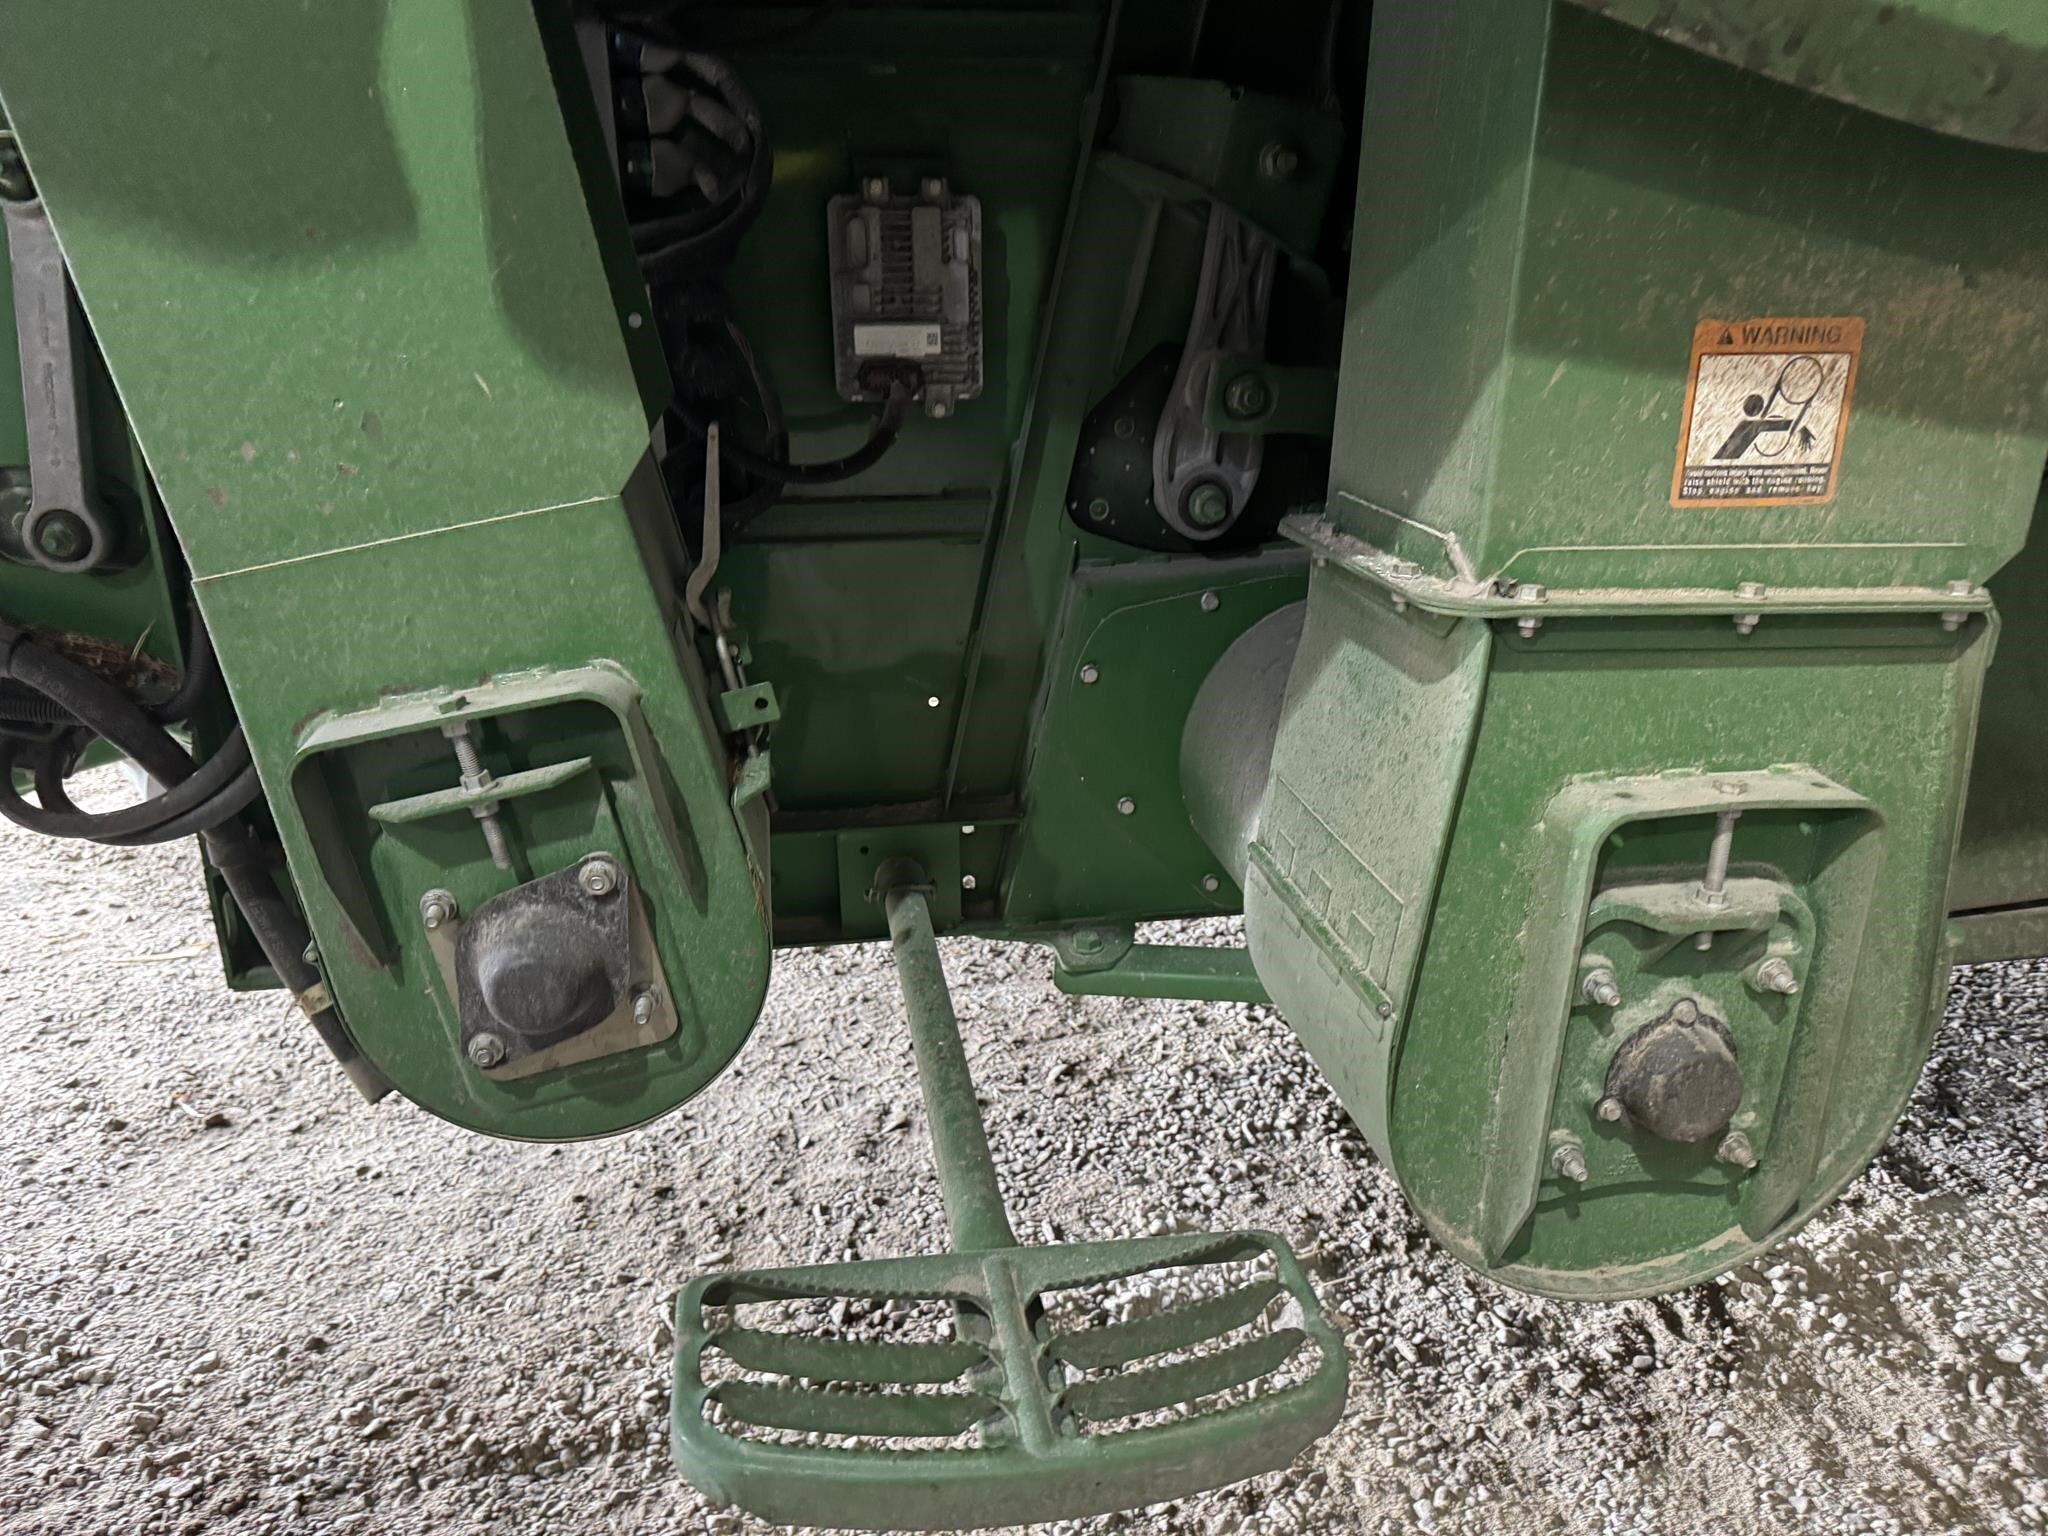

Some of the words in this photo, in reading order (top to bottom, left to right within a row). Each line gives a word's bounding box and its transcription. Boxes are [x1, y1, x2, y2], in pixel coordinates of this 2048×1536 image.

[1742, 325, 1841, 345] WARNING
[1706, 477, 1731, 486] shield
[1752, 477, 1764, 486] the
[1682, 487, 1703, 496] Stop
[1746, 485, 1762, 494] and
